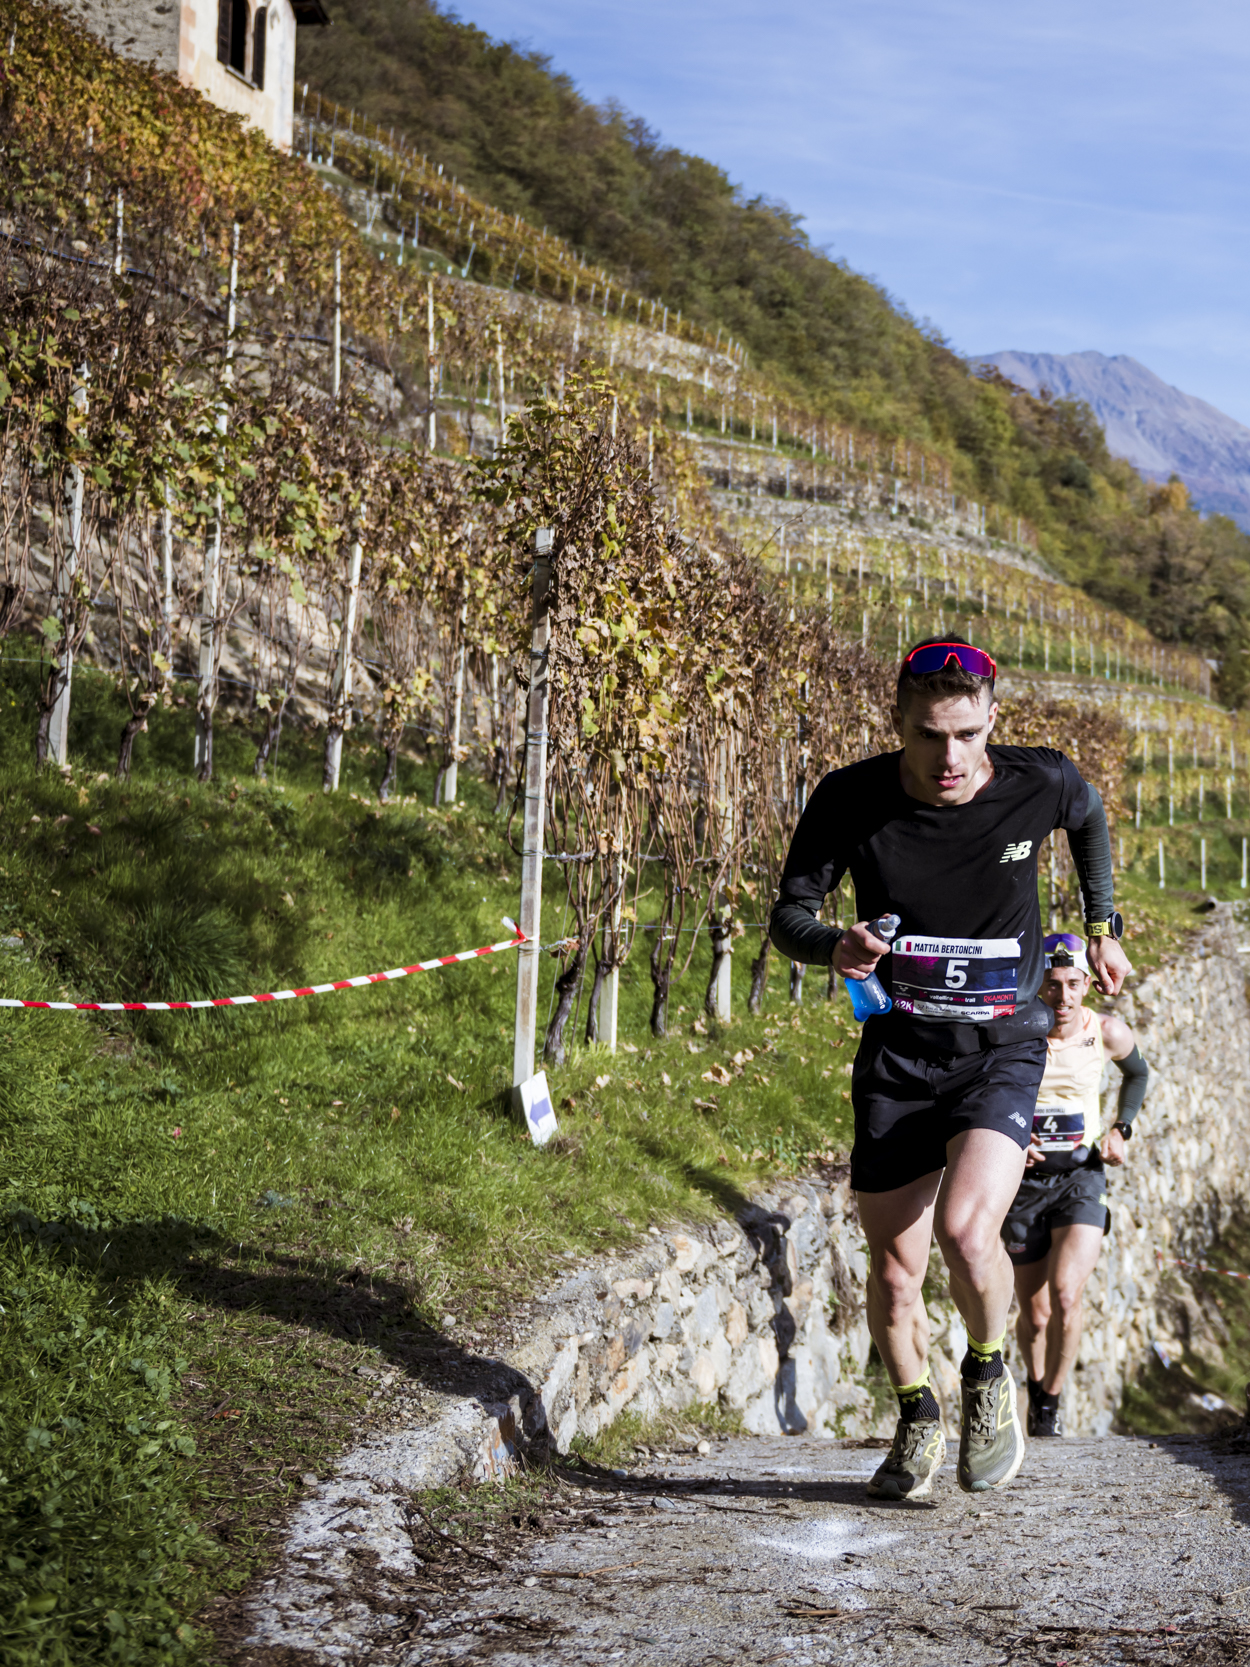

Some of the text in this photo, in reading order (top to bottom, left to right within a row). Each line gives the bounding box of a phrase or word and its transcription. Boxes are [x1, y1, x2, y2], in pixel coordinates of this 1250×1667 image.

[914, 943, 983, 955] MATTIA BERTONCINI
[945, 959, 969, 989] 5
[893, 999, 913, 1011] 42K
[983, 994, 1014, 1004] RIGAMONTI
[1043, 1116, 1058, 1133] 4
